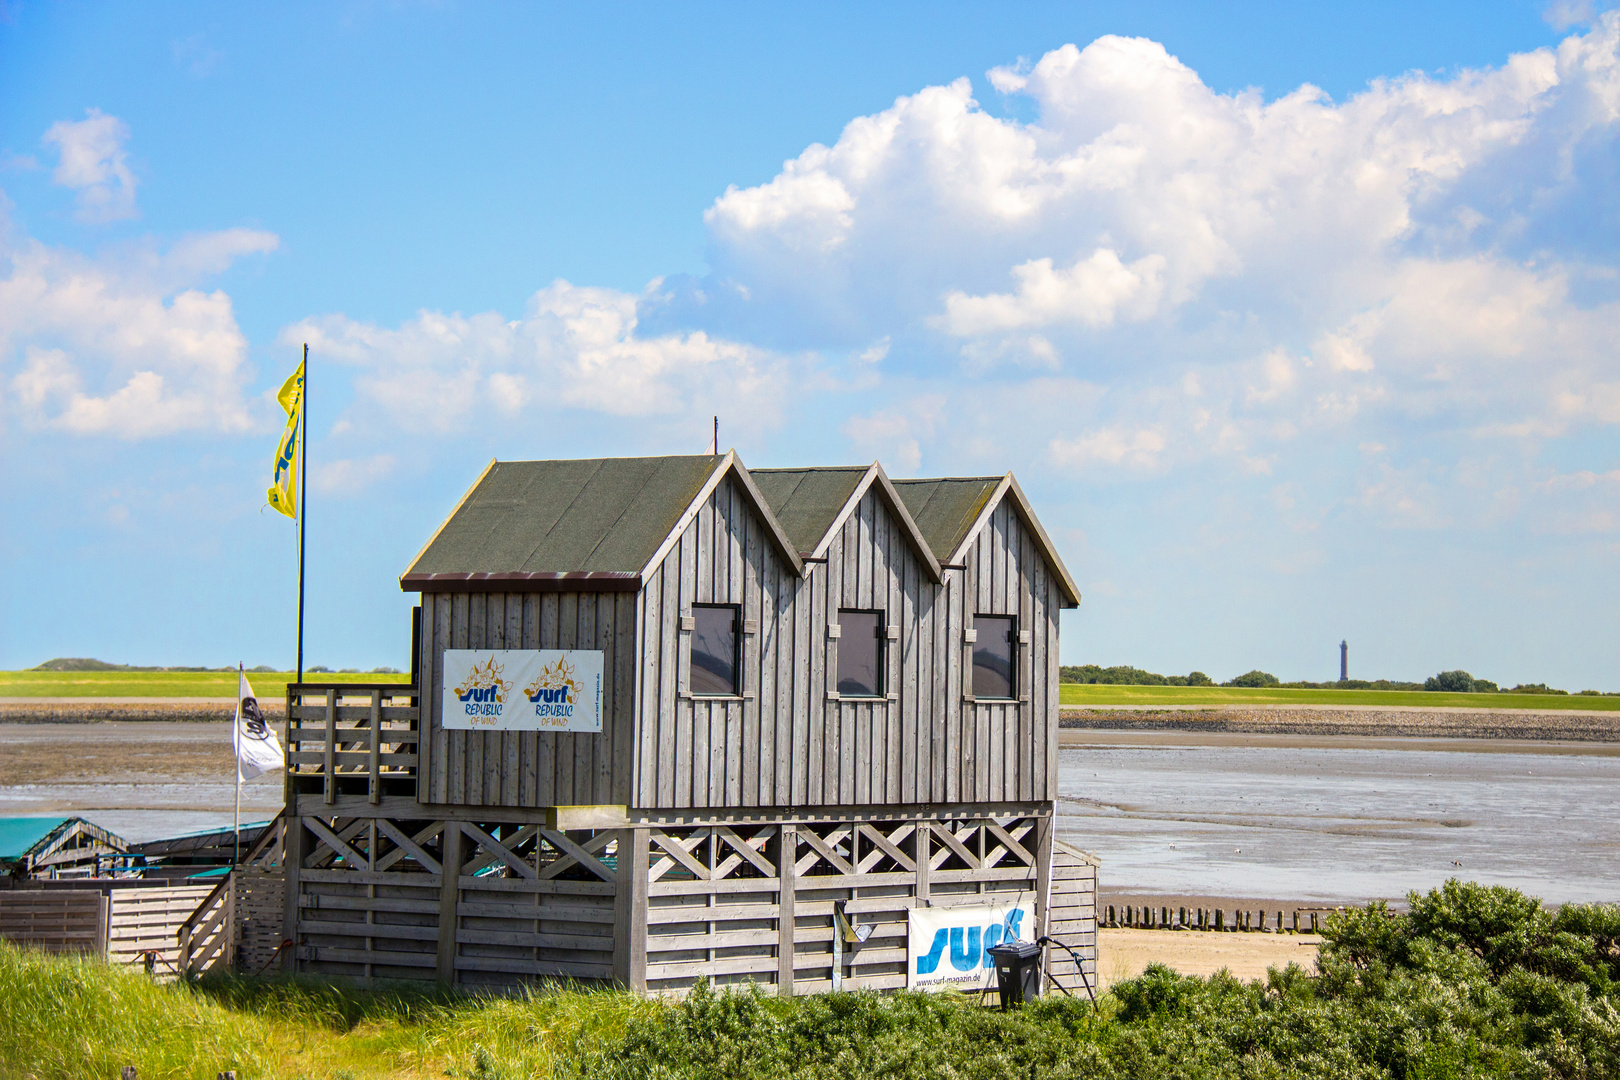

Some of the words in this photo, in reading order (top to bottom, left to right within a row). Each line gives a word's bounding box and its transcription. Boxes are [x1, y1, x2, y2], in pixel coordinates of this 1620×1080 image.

[460, 685, 498, 702] surf
[530, 686, 569, 703] surf
[465, 703, 503, 716] REPUBLIC
[535, 704, 574, 717] REPUBLIC
[470, 716, 480, 726] OF
[480, 716, 498, 726] WIND
[541, 717, 550, 727] OF
[551, 717, 569, 727] WIND
[916, 973, 981, 986] www.surf-magazin.de
